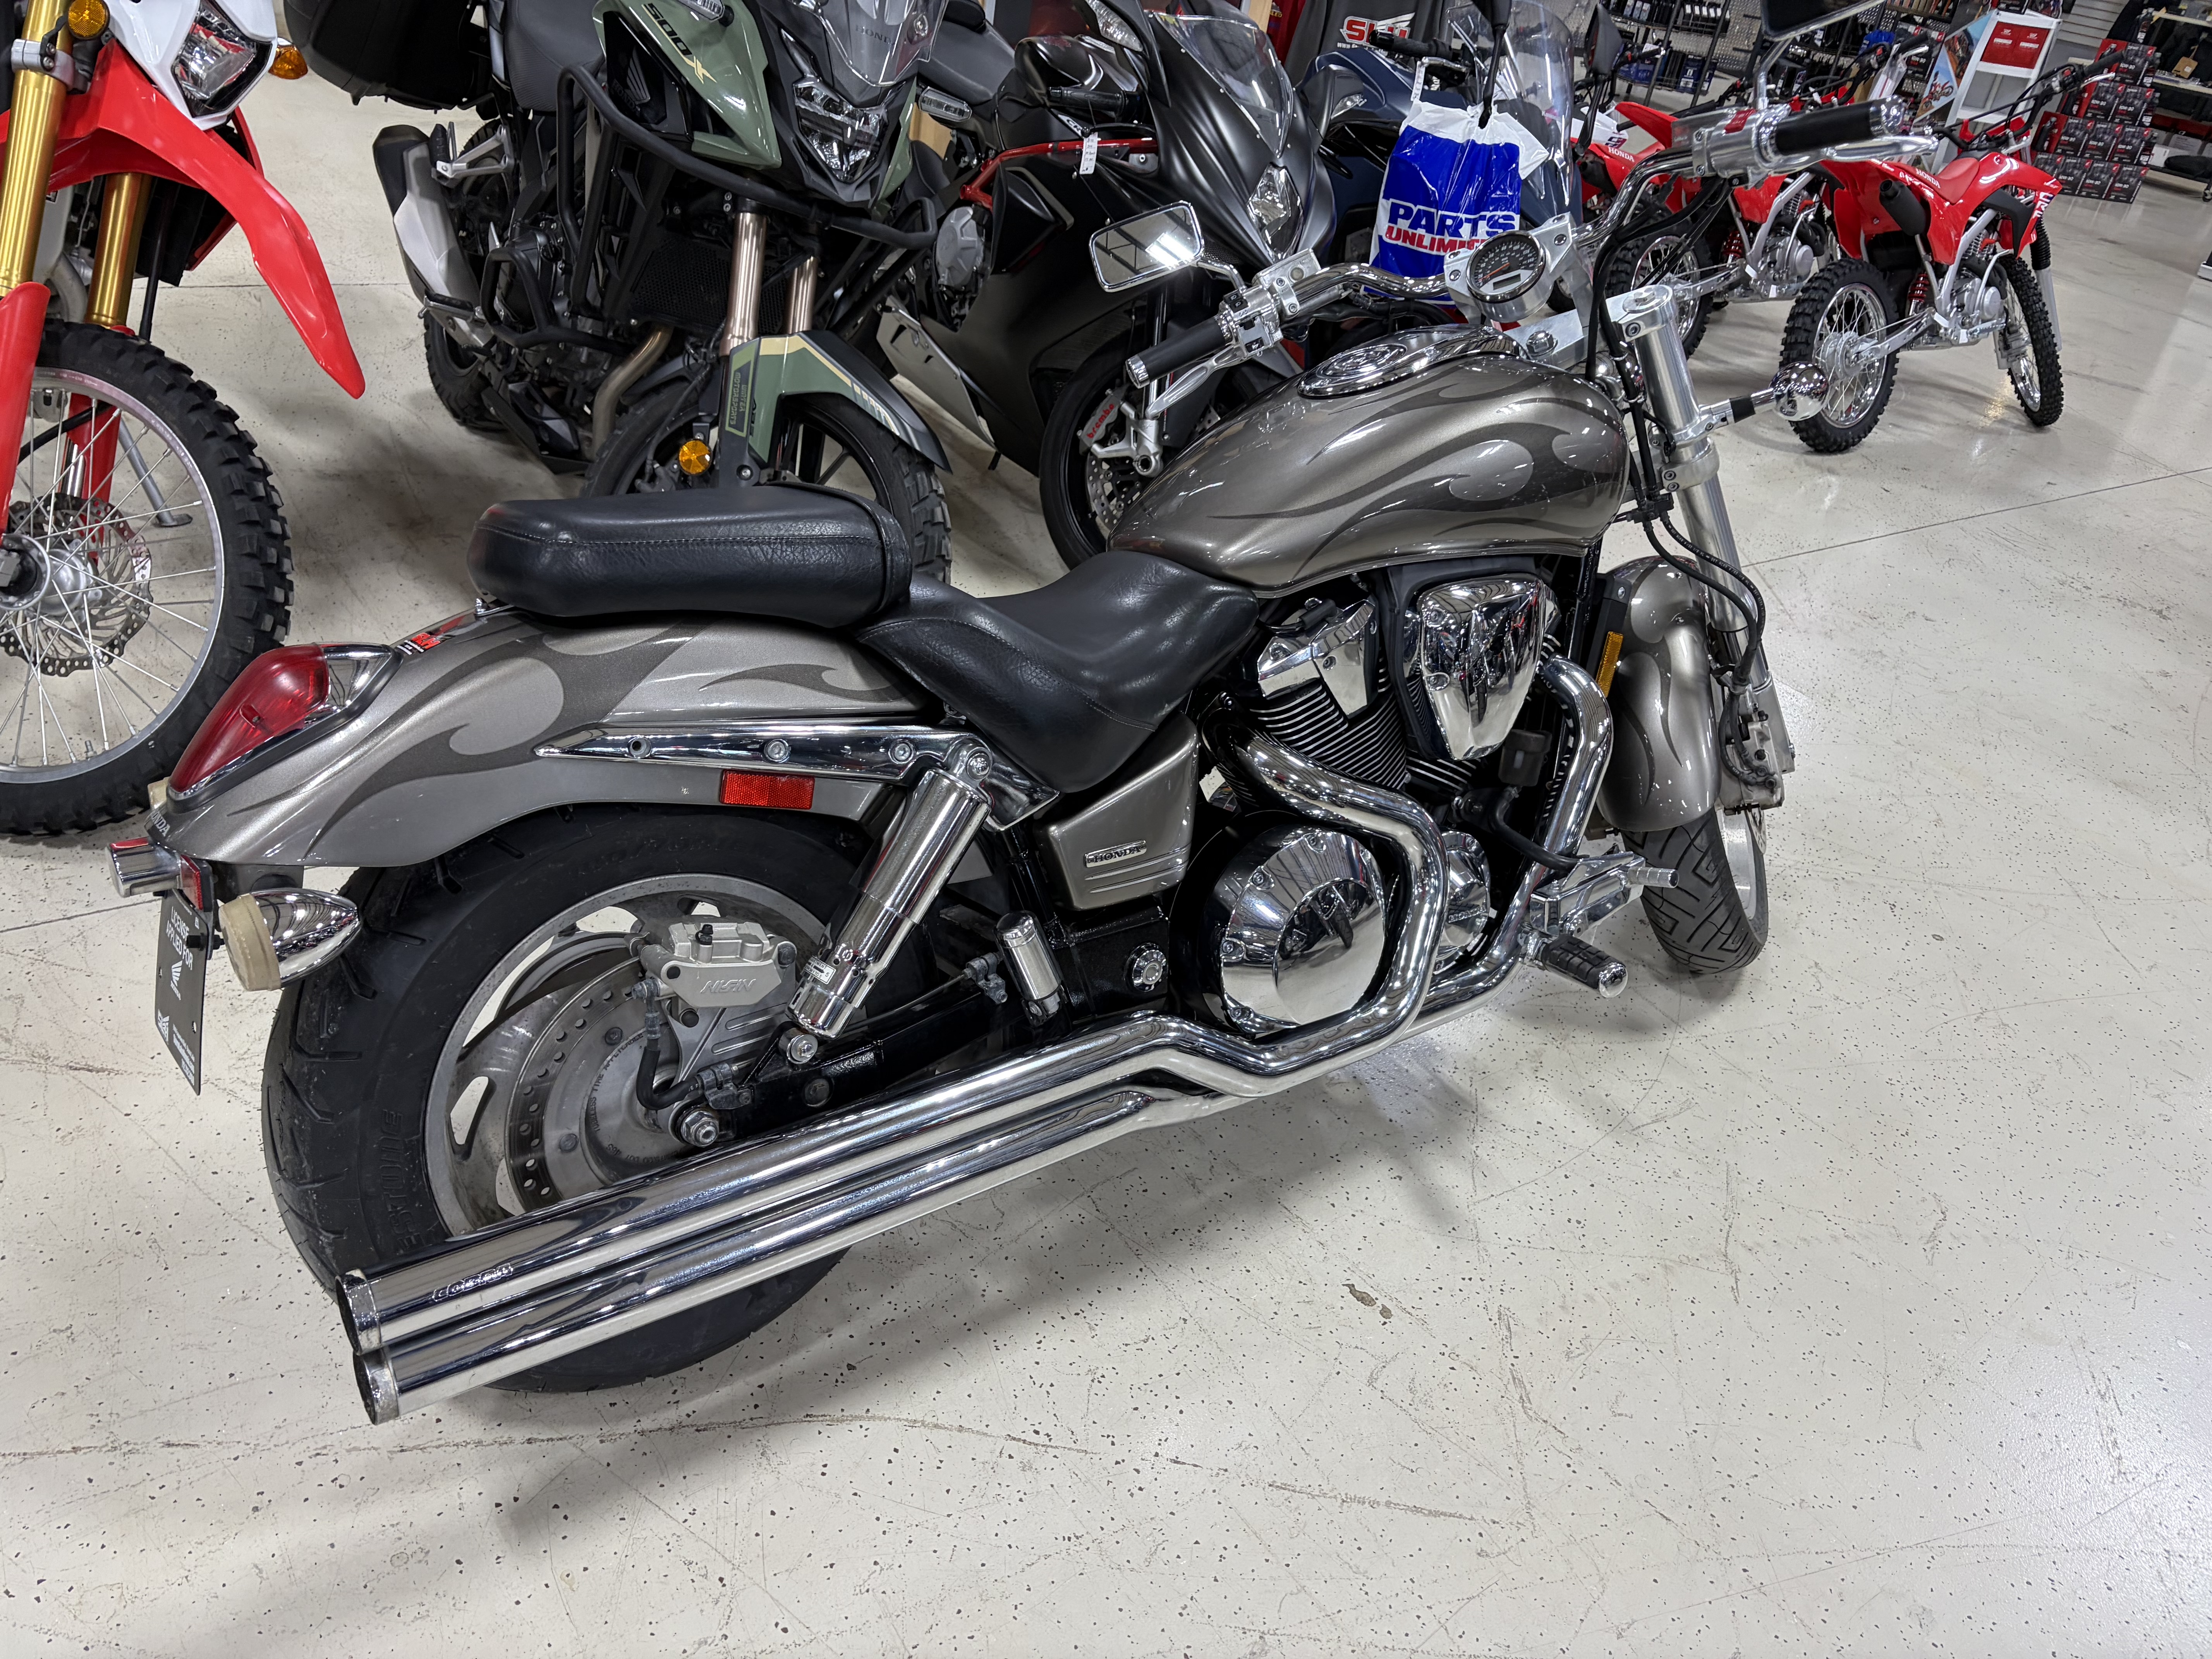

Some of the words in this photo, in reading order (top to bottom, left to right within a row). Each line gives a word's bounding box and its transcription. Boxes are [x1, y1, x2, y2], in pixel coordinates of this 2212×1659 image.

[1607, 147, 1635, 163] HONDA
[1915, 168, 1941, 189] HONDA
[1388, 201, 1516, 239] PARTS
[2032, 192, 2054, 219] CRF
[730, 372, 741, 425] MOTORSPORTS
[1086, 403, 1115, 439] brembo
[149, 811, 170, 837] ONDA
[1094, 845, 1141, 863] HONDA
[171, 906, 189, 941] LICENSE
[165, 919, 182, 956] APPLIED
[182, 943, 194, 970] FOR
[592, 1073, 604, 1091] TIRE
[590, 1096, 601, 1132] TUBELESS
